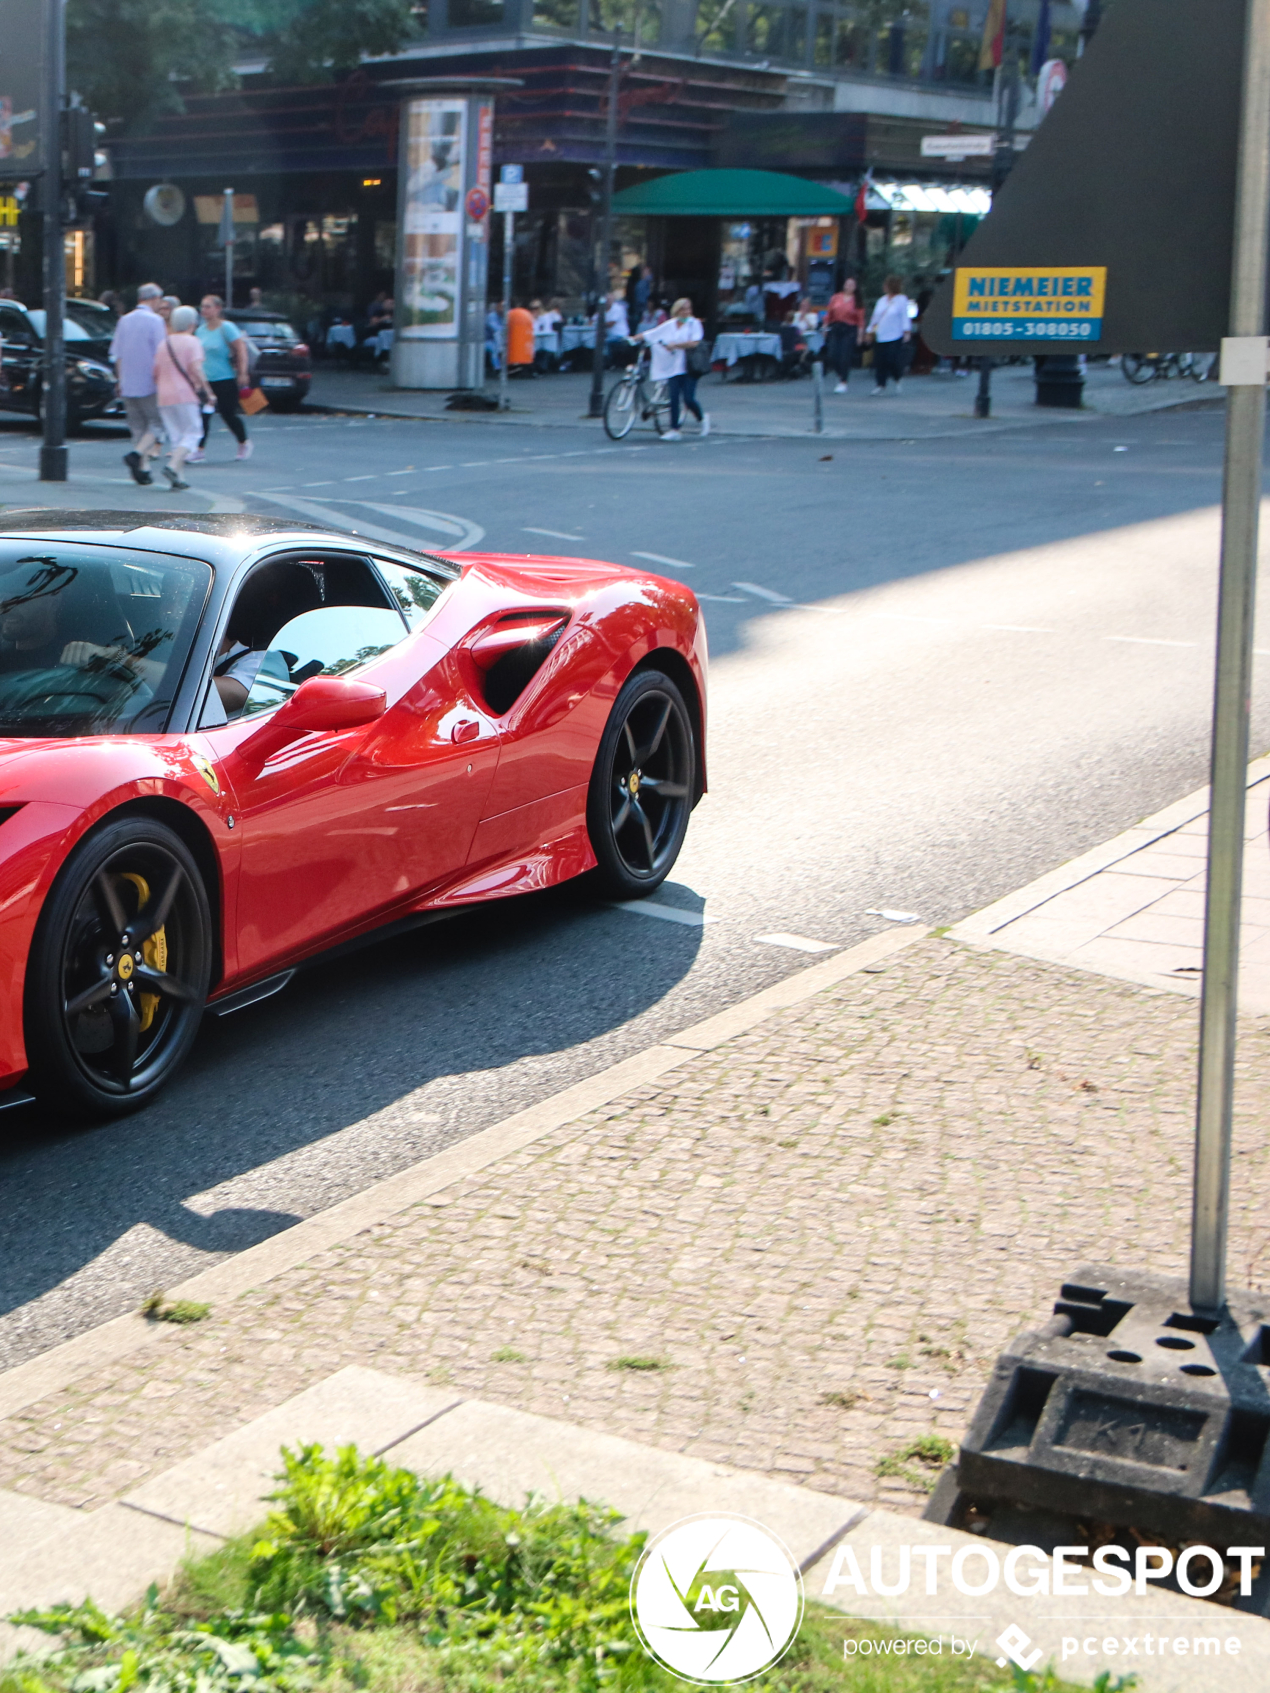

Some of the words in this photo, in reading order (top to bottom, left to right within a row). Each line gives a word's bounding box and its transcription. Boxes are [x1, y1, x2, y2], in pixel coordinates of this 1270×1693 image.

[967, 276, 1094, 297] NIEMEIER
[966, 300, 1091, 312] MIETSTATION
[962, 322, 1091, 336] 01805-308050
